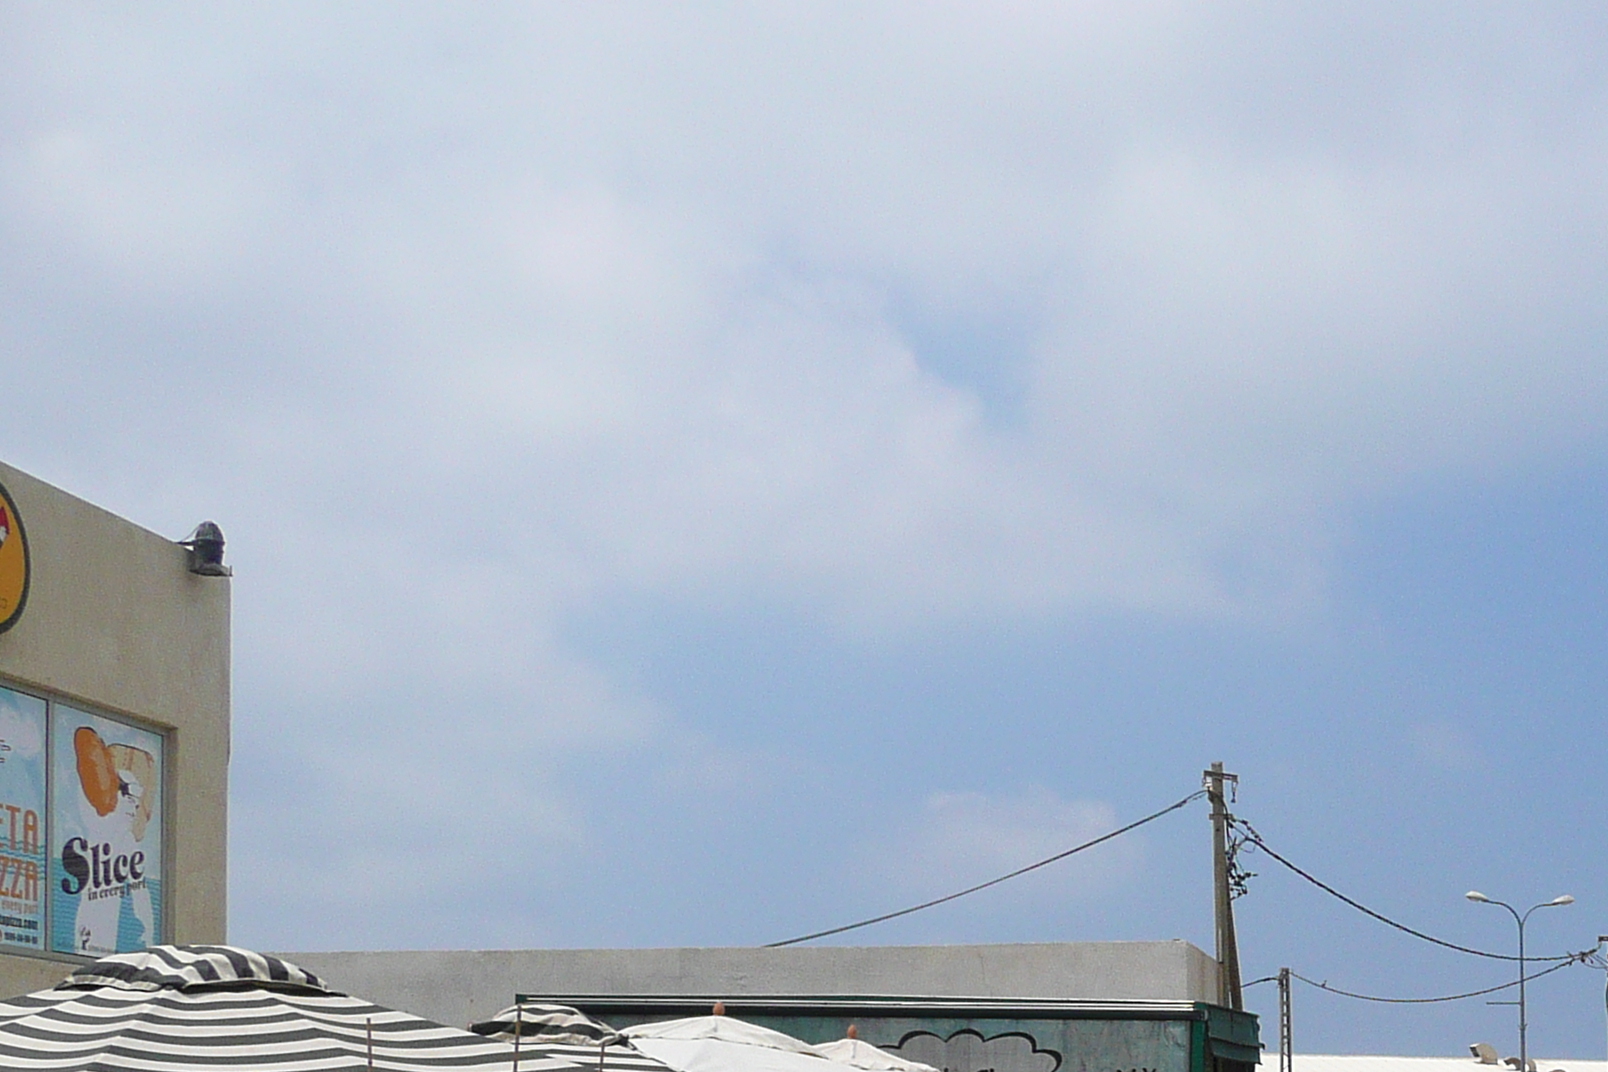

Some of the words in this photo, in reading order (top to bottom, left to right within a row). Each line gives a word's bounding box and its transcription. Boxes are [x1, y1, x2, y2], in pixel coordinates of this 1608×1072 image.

[61, 836, 147, 896] Slice
[88, 887, 98, 901] in
[99, 885, 125, 900] every
[126, 877, 147, 897] port
